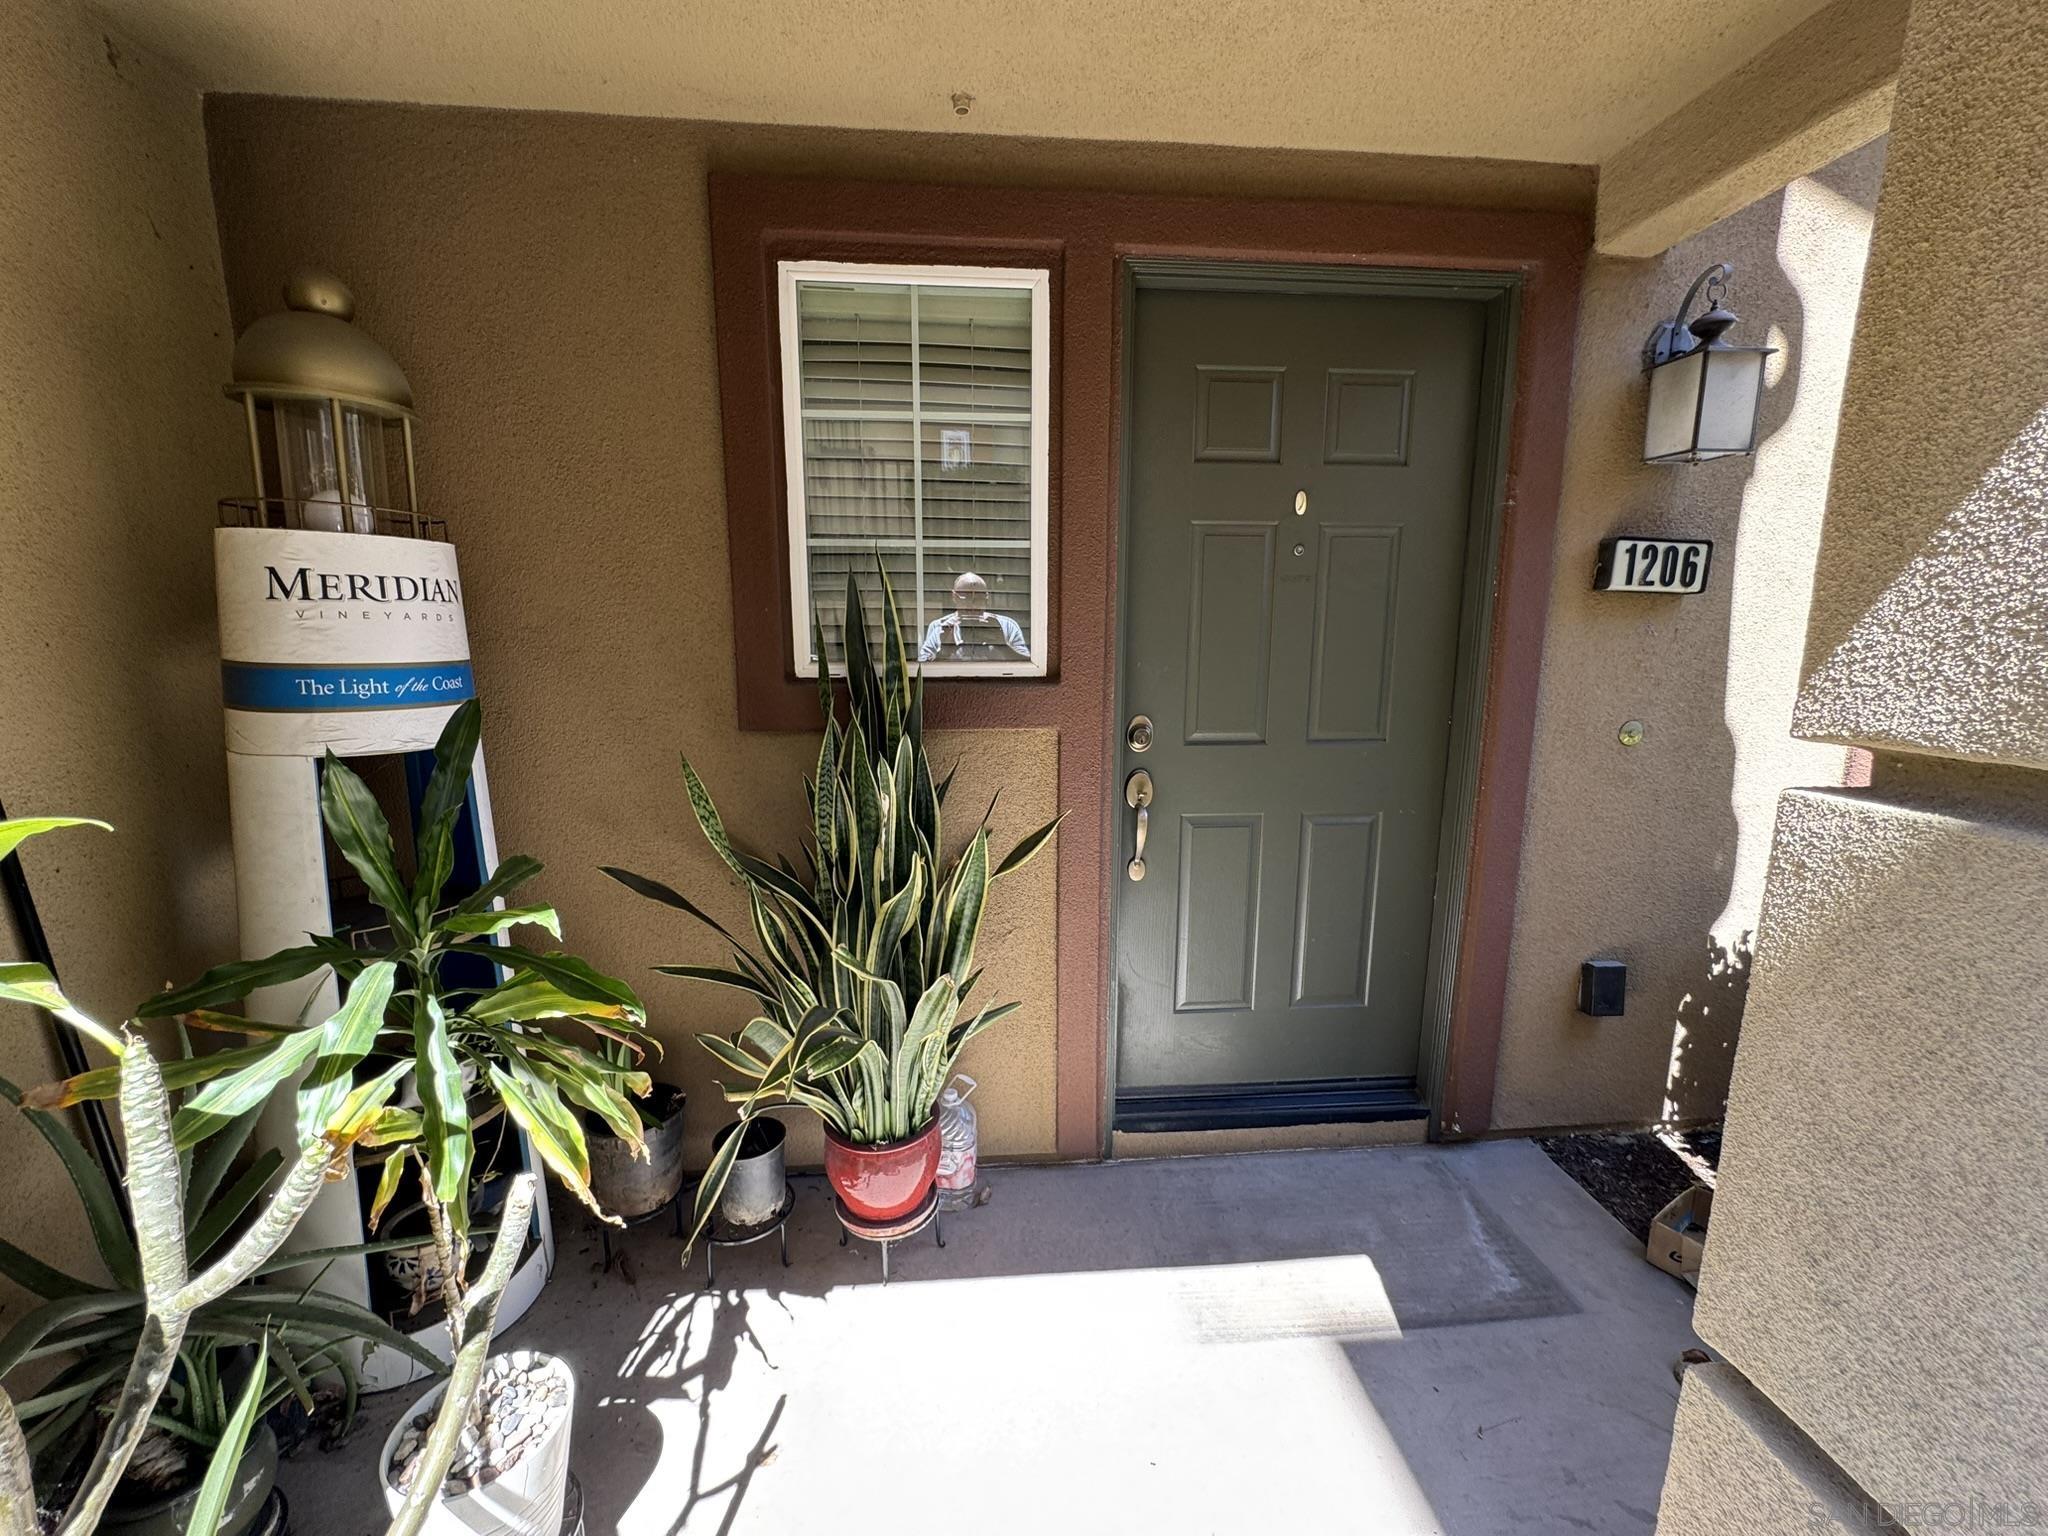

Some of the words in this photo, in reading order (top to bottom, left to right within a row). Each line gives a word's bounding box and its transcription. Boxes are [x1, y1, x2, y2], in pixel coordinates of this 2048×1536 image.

[1625, 543, 1700, 588] 1206
[264, 566, 460, 603] MERIDIAN
[296, 609, 454, 622] VINEYARDS
[296, 678, 333, 696] The
[340, 677, 389, 698] Light
[395, 677, 412, 697] of
[411, 677, 429, 691] the
[432, 675, 462, 690] Coast
